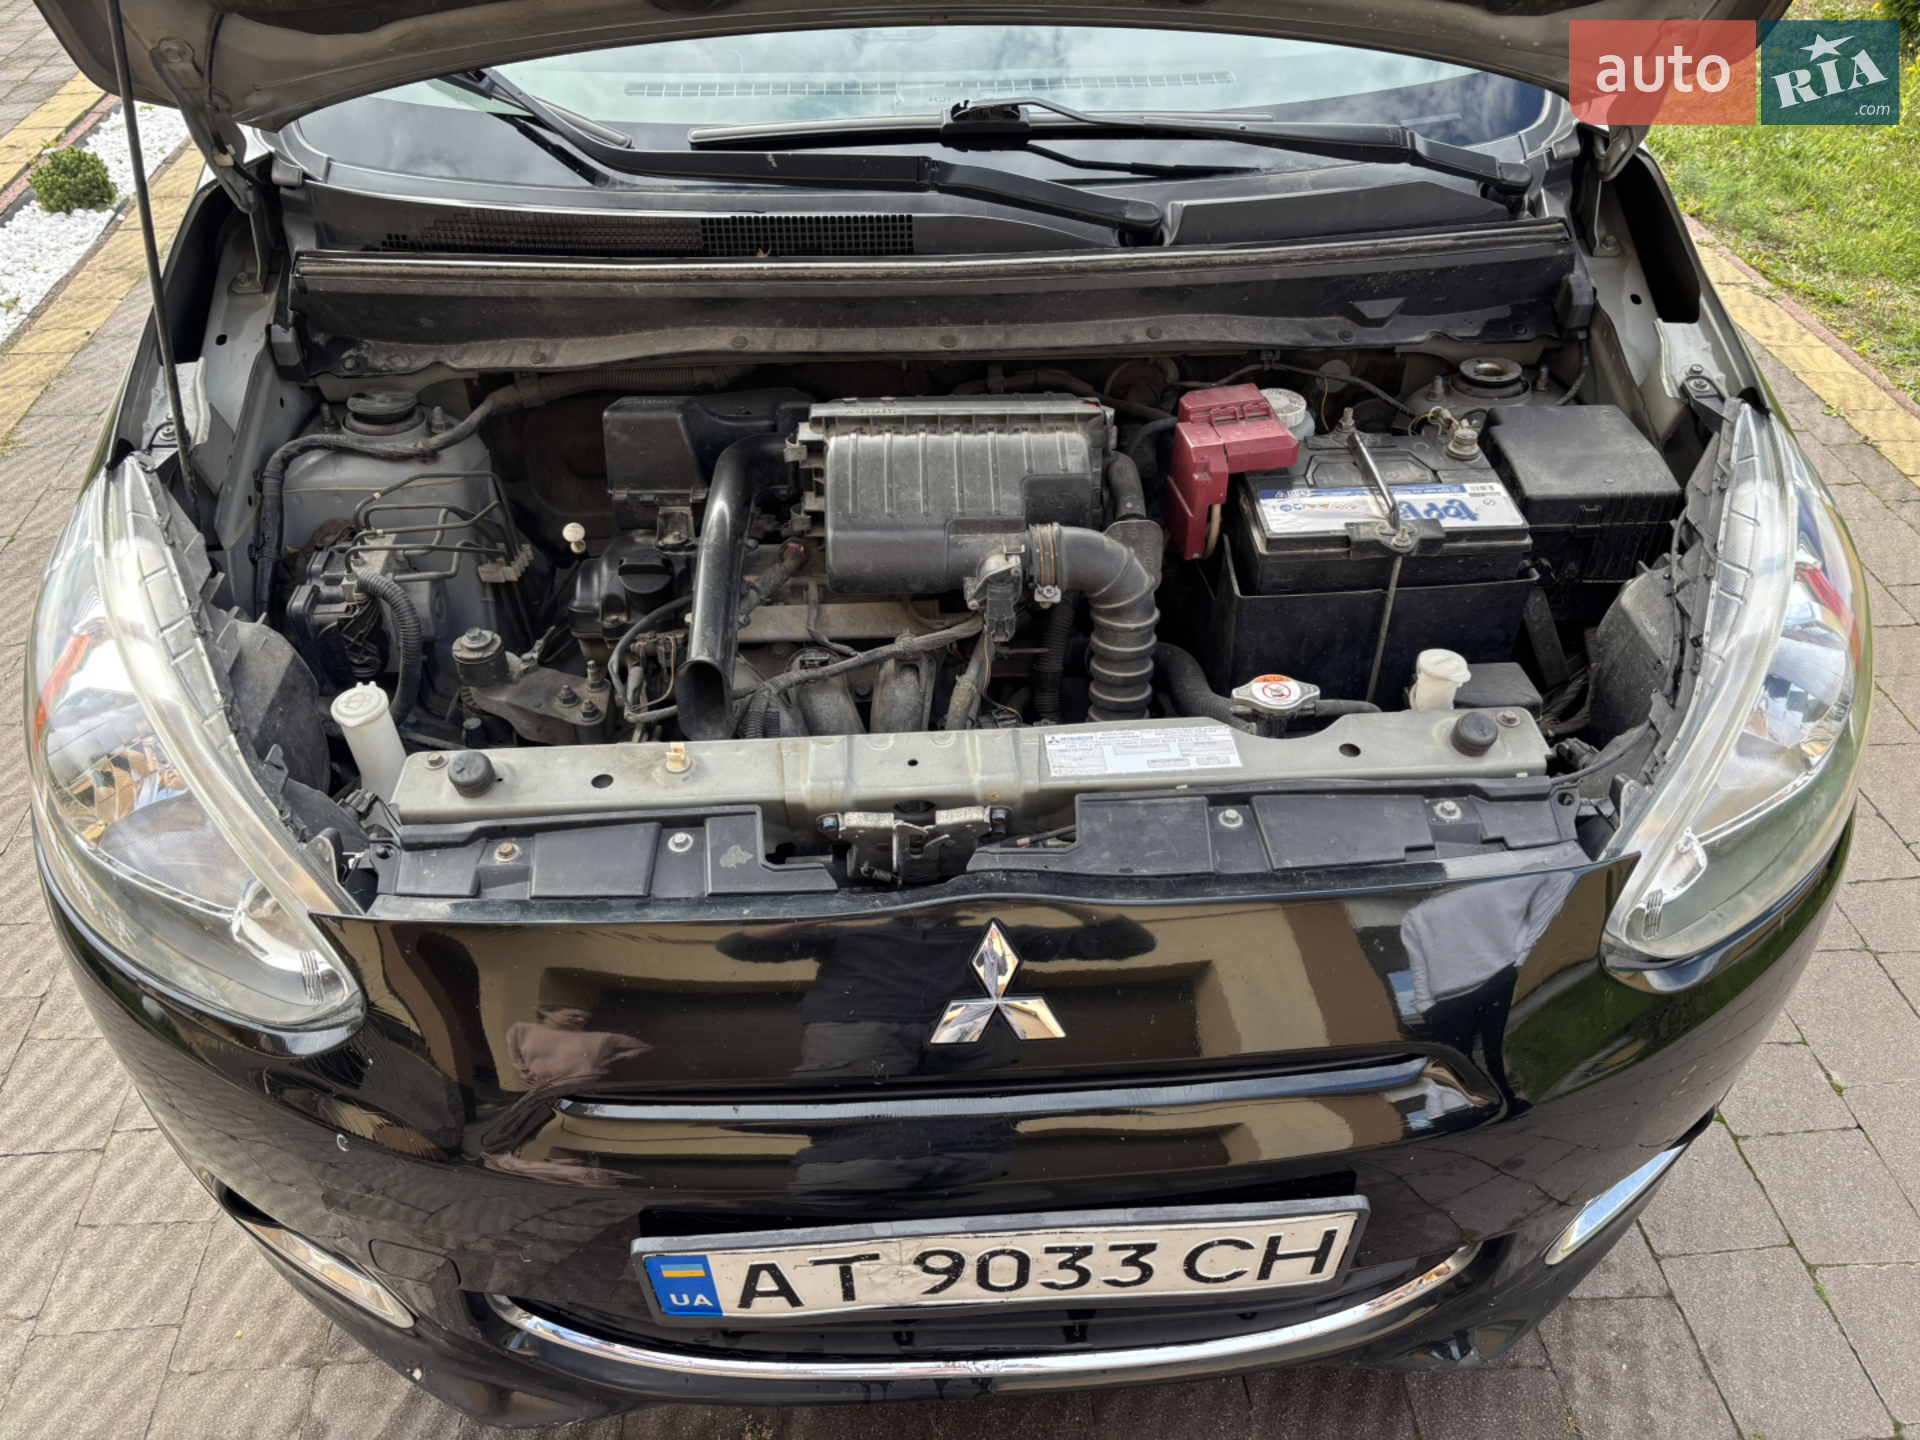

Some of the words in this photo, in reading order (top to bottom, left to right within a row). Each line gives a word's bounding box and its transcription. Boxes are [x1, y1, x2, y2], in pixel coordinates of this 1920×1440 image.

[737, 1252, 880, 1309] AT
[912, 1241, 1159, 1295] 9033
[1182, 1228, 1339, 1284] CH
[669, 1293, 714, 1307] UA
